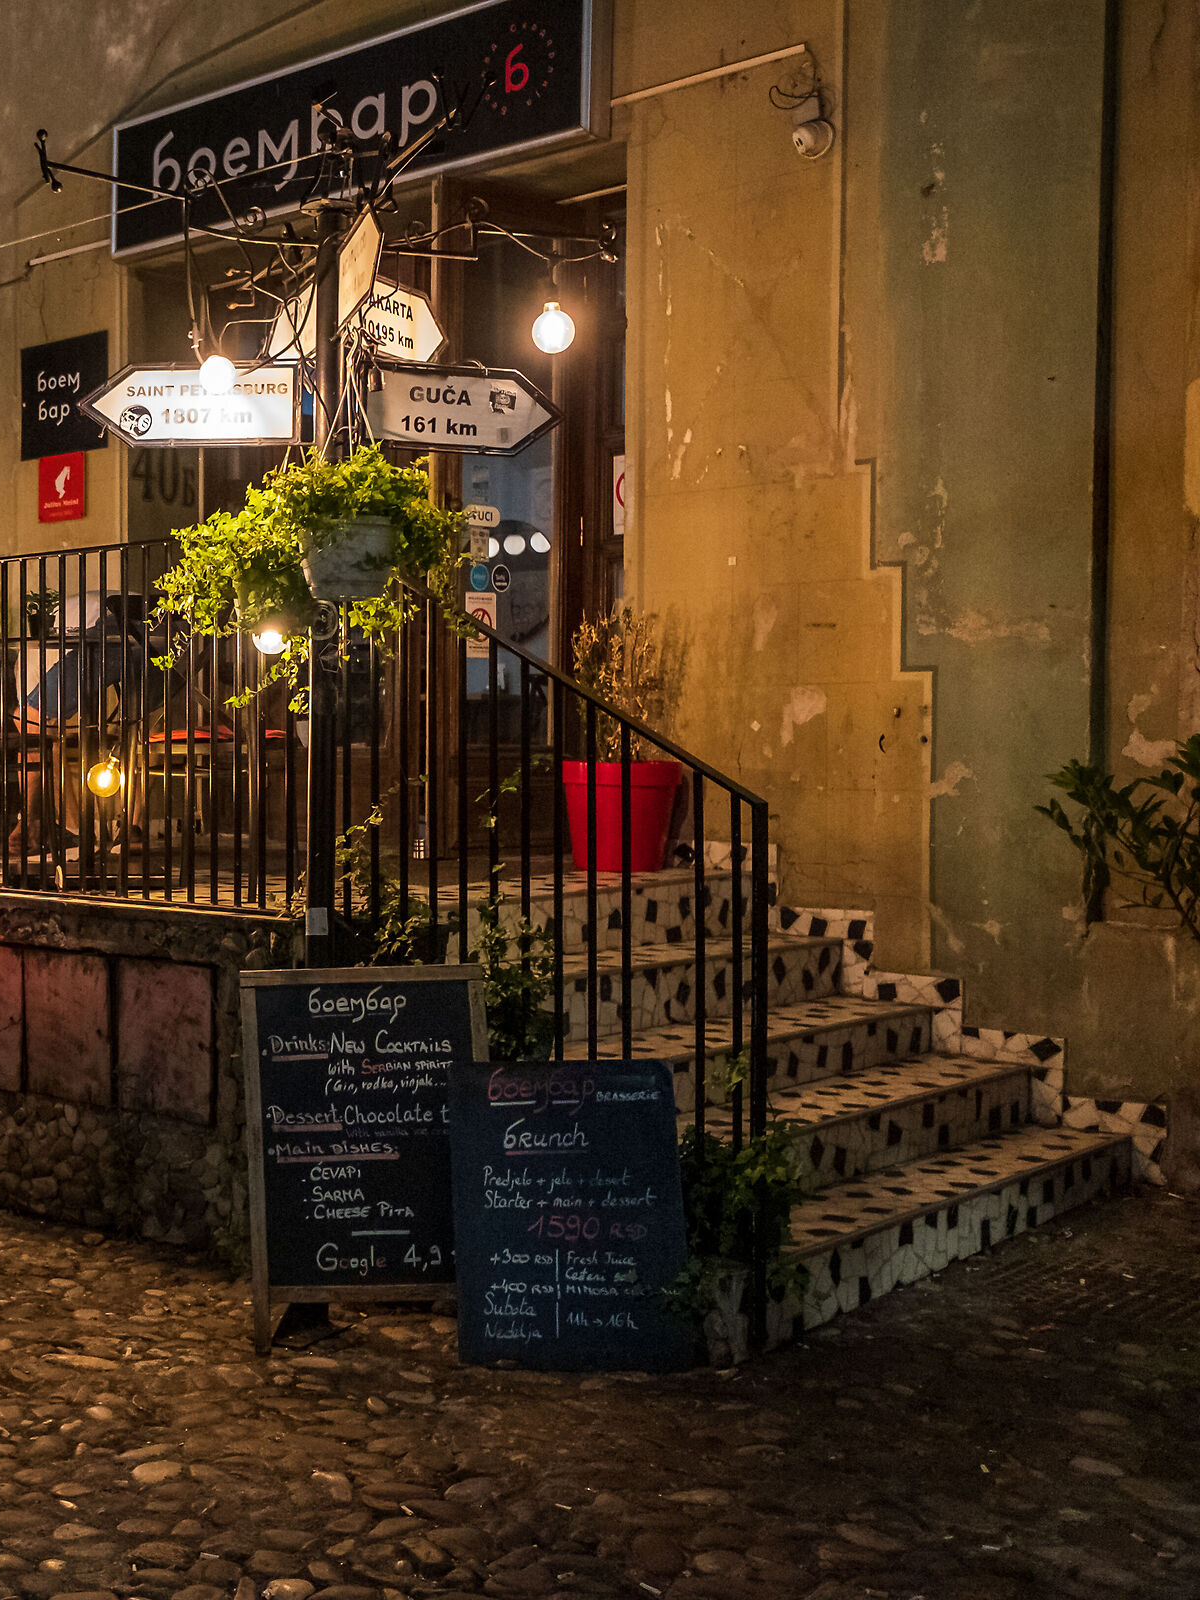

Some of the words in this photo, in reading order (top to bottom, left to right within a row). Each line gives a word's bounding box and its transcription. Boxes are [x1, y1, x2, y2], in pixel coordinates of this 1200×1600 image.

[398, 330, 413, 350] km
[37, 371, 80, 394] боем
[126, 385, 175, 397] SAINT
[409, 385, 472, 406] GUČA
[38, 400, 70, 426] бар
[161, 408, 211, 424] 1807
[220, 408, 253, 424] km
[401, 415, 437, 433] 161
[446, 418, 477, 436] km
[344, 1104, 434, 1125] Chocolate
[311, 1186, 365, 1203] SARMA
[484, 1189, 534, 1209] Starter
[552, 1196, 583, 1208] main
[313, 1204, 372, 1220] CHEESE
[527, 1214, 600, 1241] 1590
[610, 1222, 648, 1241] RSD
[316, 1242, 389, 1276] Google
[534, 1254, 554, 1265] RSD
[567, 1250, 598, 1265] Fresh
[531, 1284, 555, 1295] RSD
[484, 1291, 537, 1316] Subota
